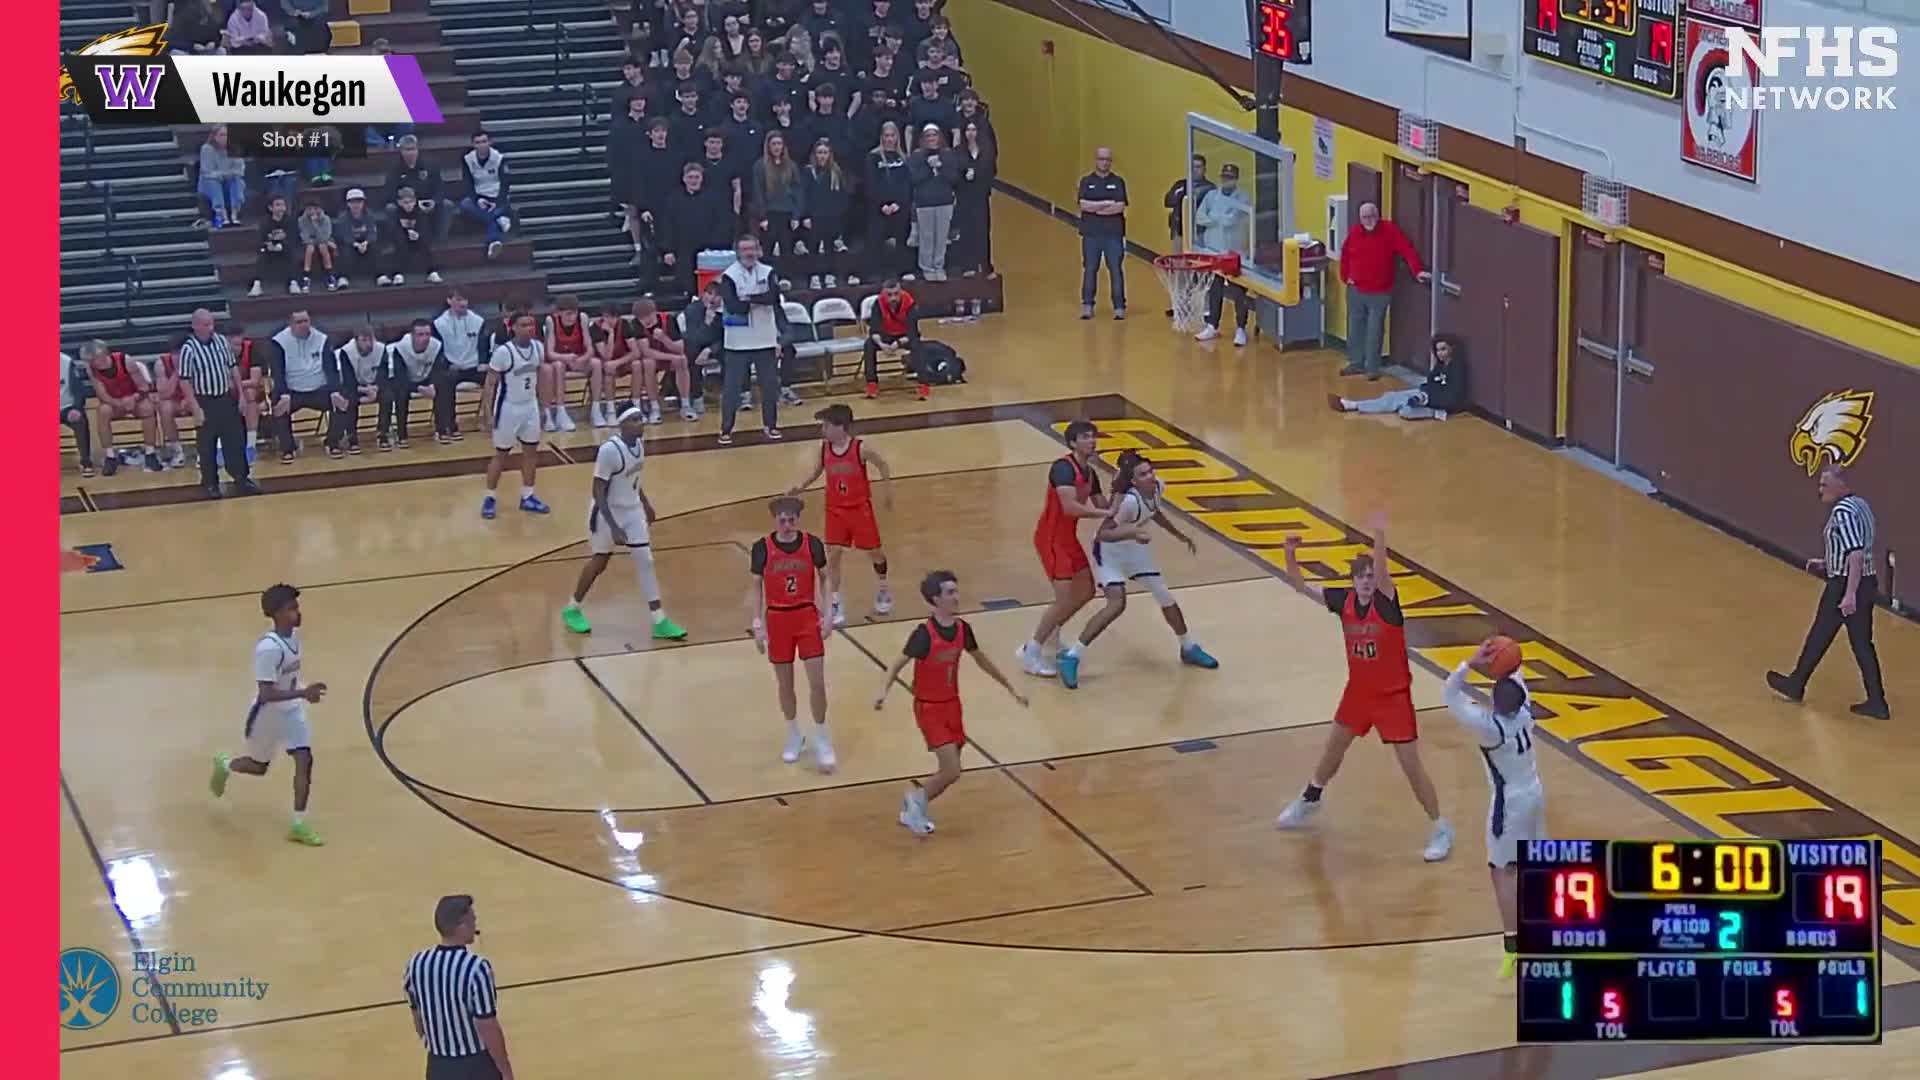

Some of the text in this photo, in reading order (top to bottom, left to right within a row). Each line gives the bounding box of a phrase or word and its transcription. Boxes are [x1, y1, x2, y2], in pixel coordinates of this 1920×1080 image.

[1262, 6, 1289, 56] 35
[1603, 40, 1616, 74] 2
[524, 377, 531, 390] 2
[785, 575, 797, 593] 2
[1353, 641, 1377, 659] 40
[1515, 727, 1532, 755] 11
[1408, 641, 1920, 950] EAGL
